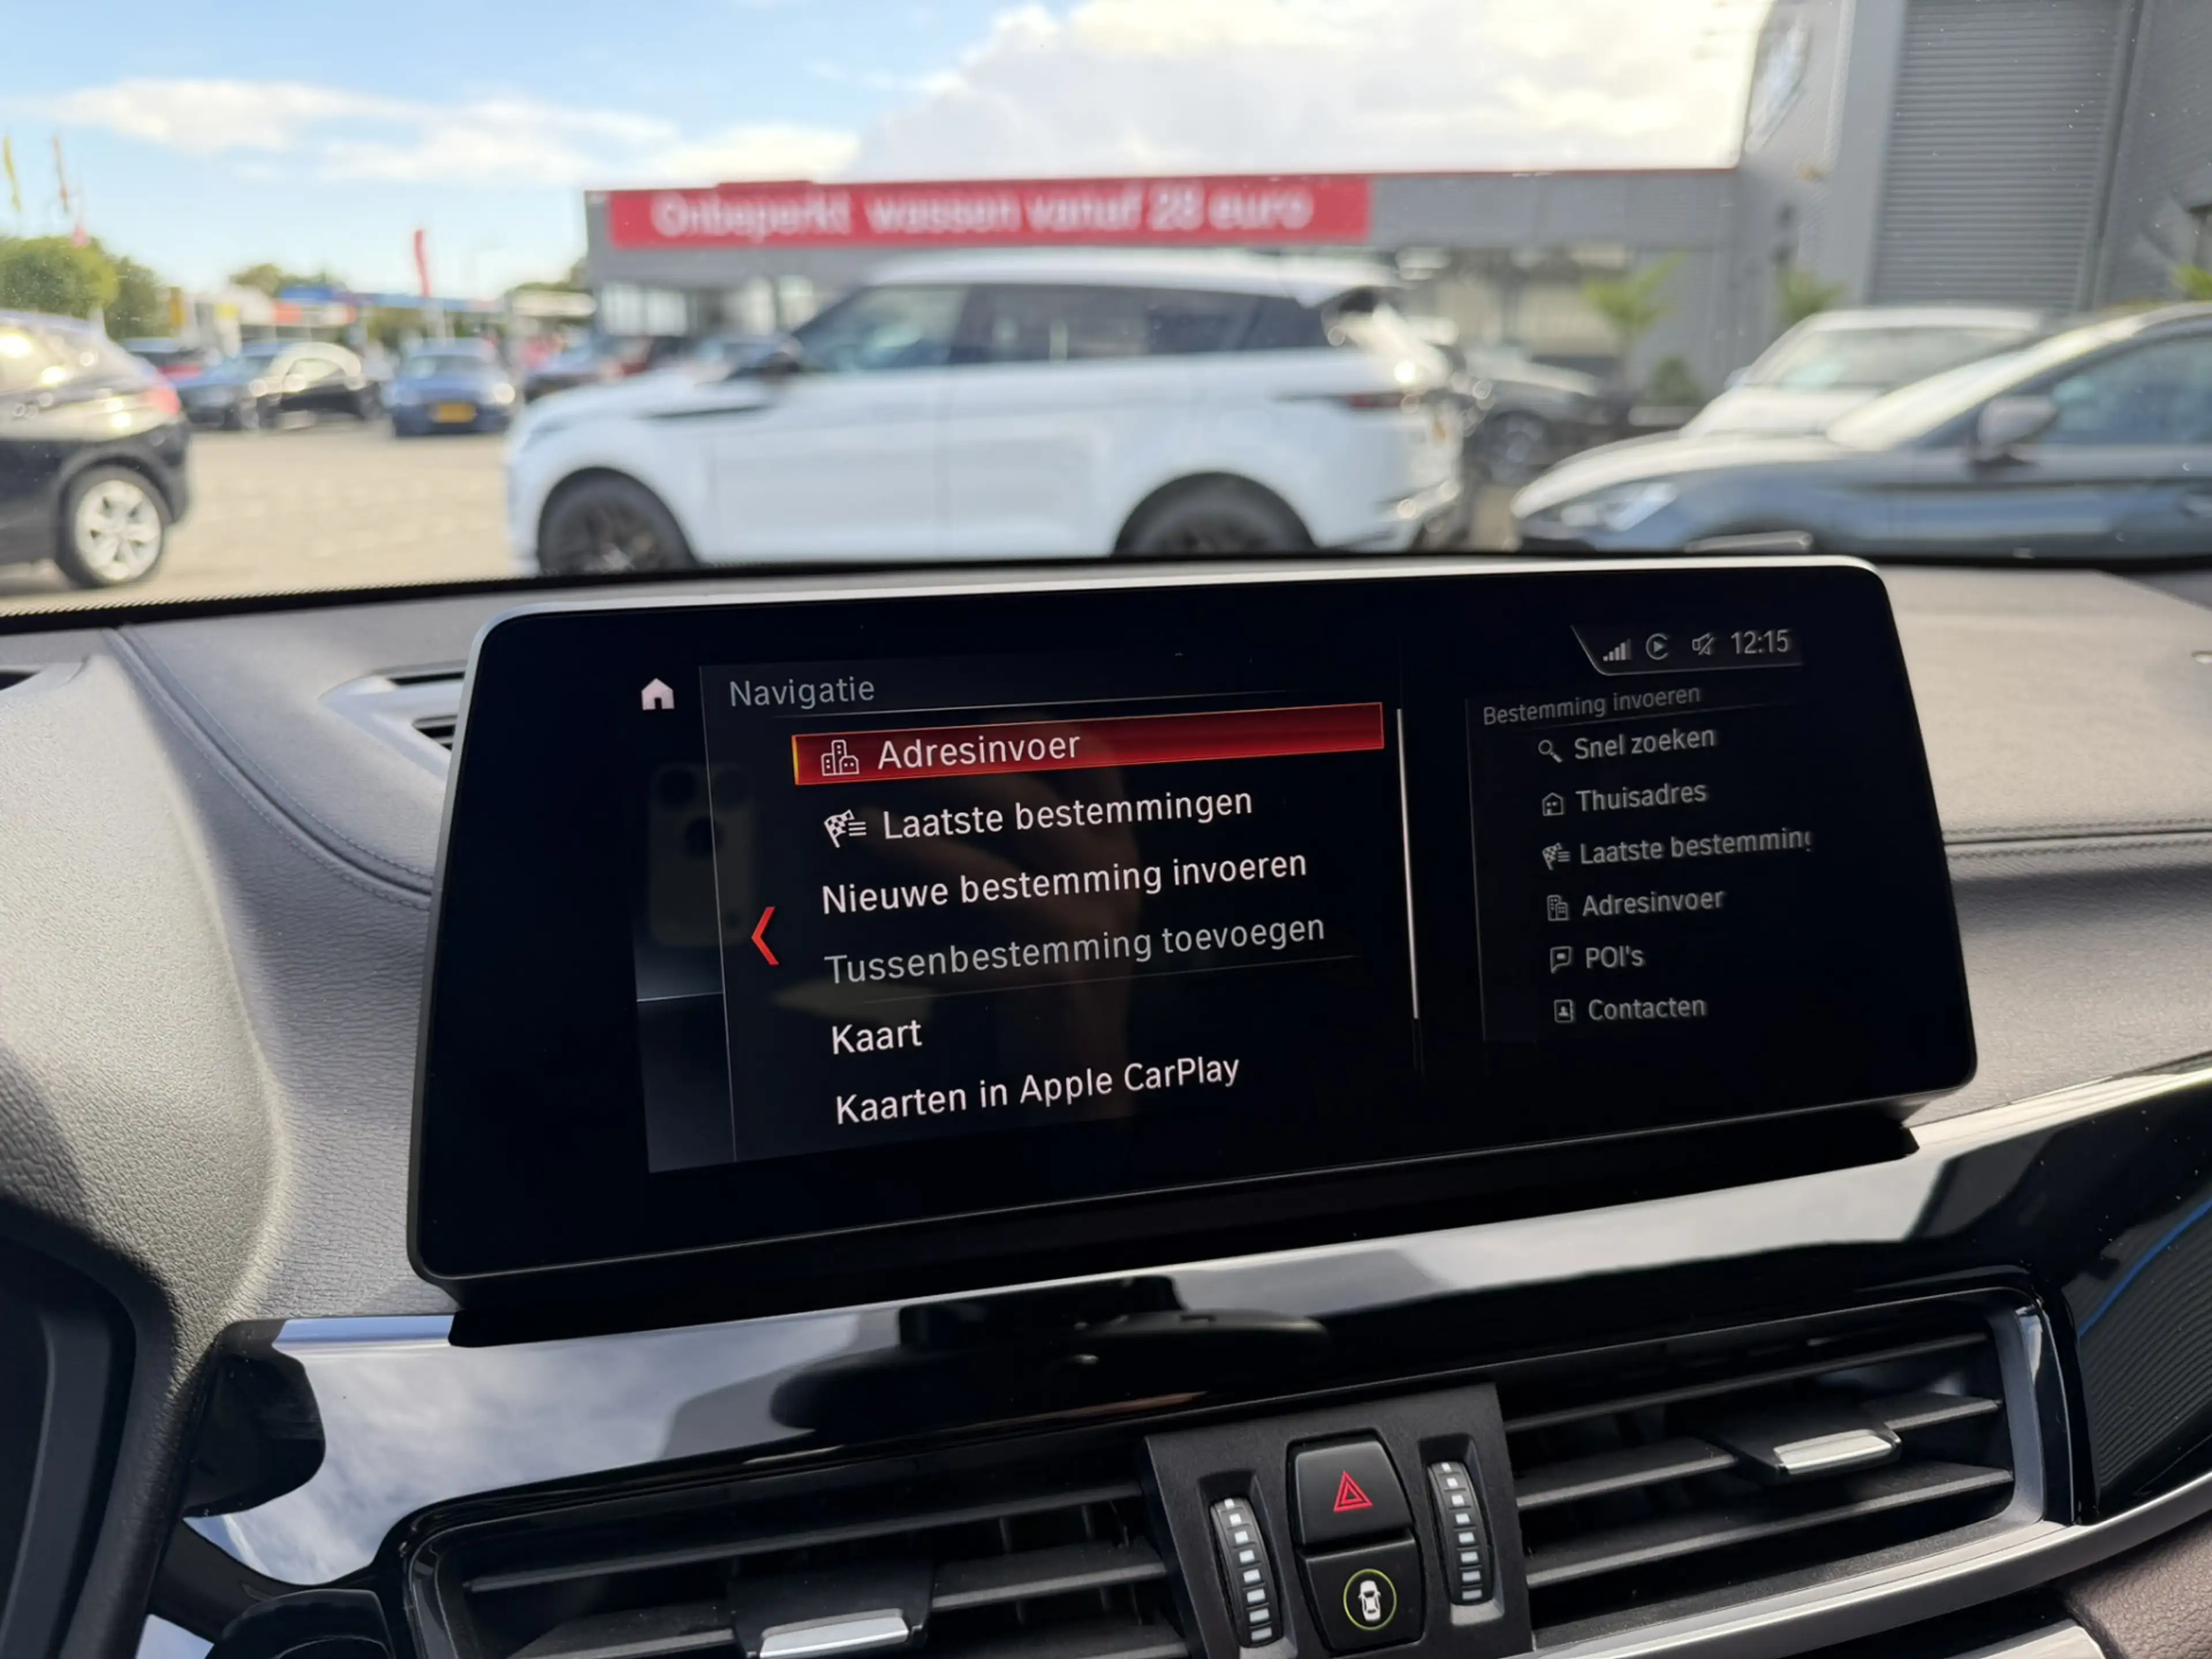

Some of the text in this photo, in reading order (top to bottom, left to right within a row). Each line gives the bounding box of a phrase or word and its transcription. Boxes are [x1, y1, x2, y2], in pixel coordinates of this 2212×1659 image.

[1732, 629, 1790, 656] 12:15
[729, 676, 876, 709] Navigatie
[1483, 687, 1702, 726] Bestemming invoeren
[877, 733, 1079, 770] Adresinvoer
[1574, 728, 1716, 760] Snel zoeken
[1575, 783, 1709, 812] Thuisadres
[882, 791, 1253, 840] Laatste bestemmingen
[1580, 839, 1665, 865] Laatste
[822, 853, 1308, 914] Nieuwe bestemming invoeren
[1582, 889, 1725, 917] Adresinvoer
[824, 918, 1325, 984] Tussenbestemming toevoegen
[1588, 997, 1708, 1021] Contacten
[832, 1020, 922, 1055] Kaart
[835, 1055, 1240, 1124] Kaarten in Apple CarPlay
